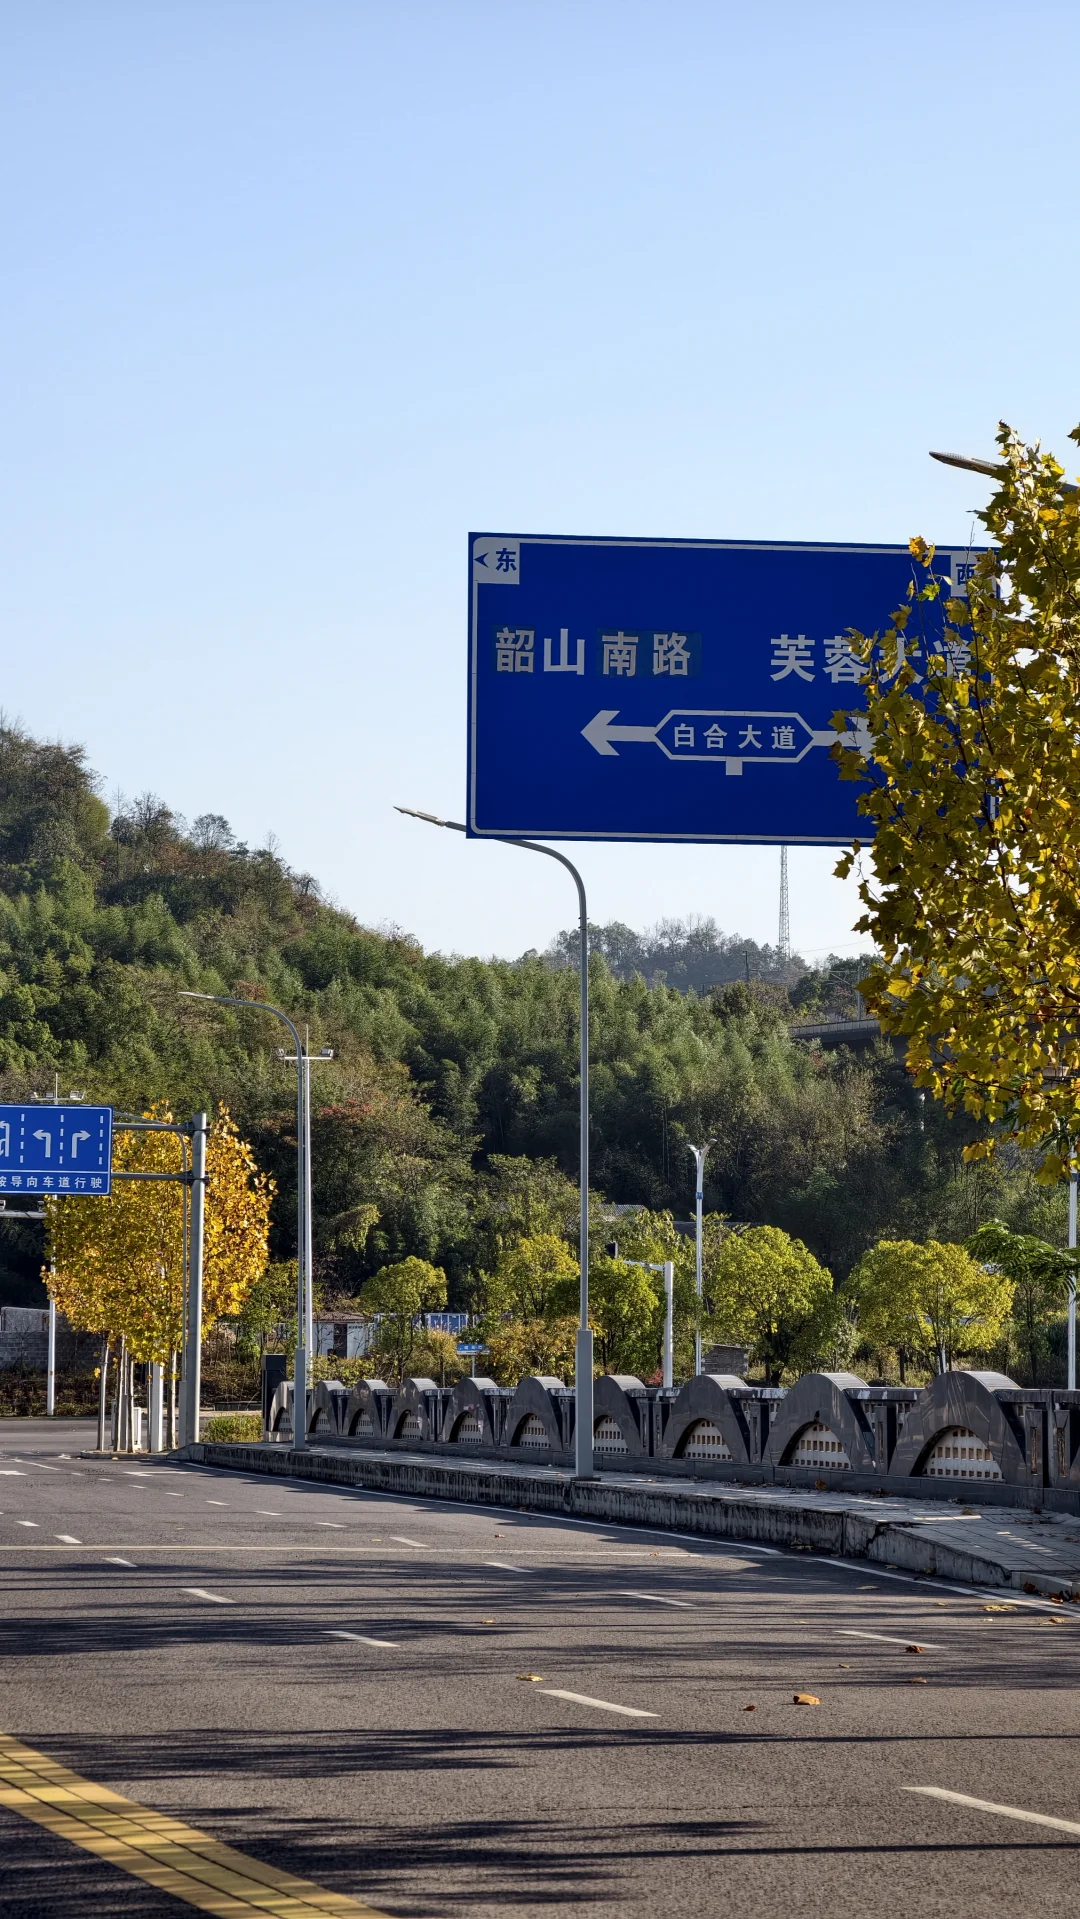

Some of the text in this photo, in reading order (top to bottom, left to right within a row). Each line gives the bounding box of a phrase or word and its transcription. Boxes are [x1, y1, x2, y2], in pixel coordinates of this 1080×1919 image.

[495, 547, 517, 573] 东
[495, 627, 692, 677] 韶山南路
[673, 723, 797, 750] 白合大道
